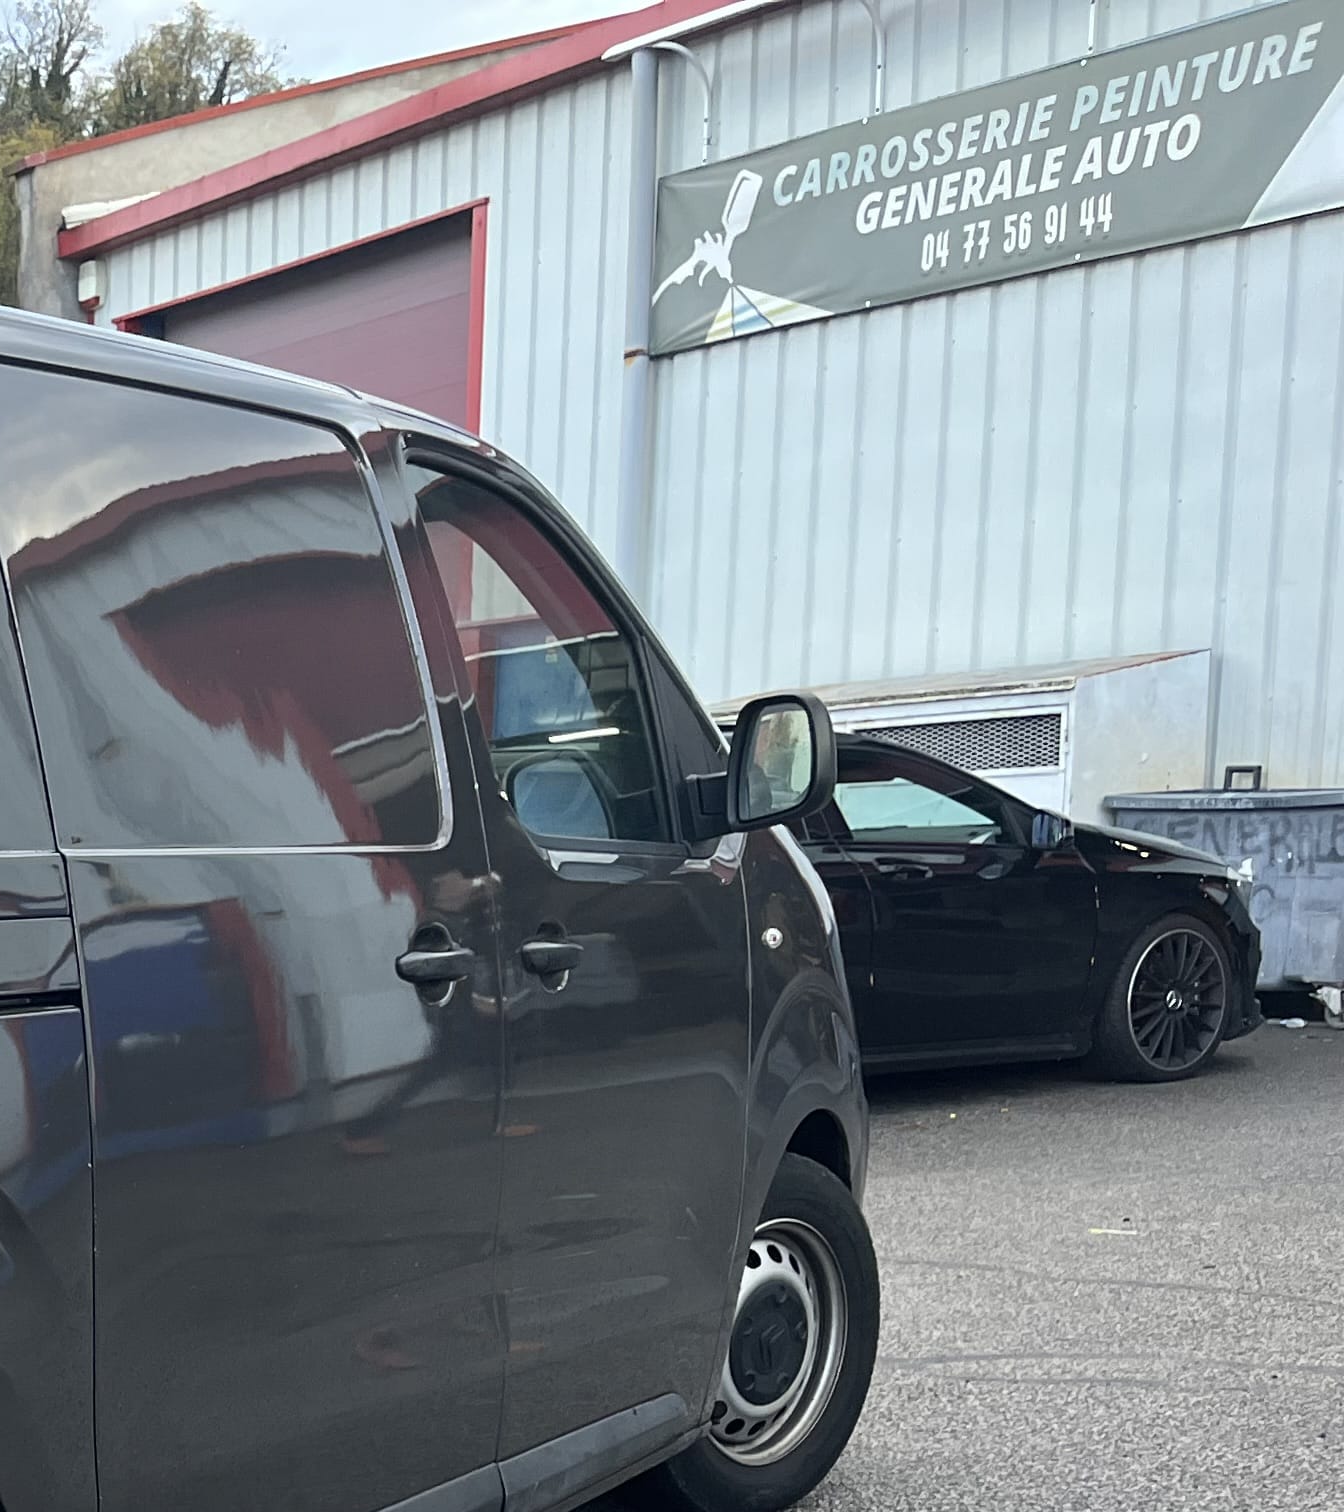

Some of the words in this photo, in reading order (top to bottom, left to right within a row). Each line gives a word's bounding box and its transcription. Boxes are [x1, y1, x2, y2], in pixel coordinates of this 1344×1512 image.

[773, 94, 1058, 206] CARROSSERIE
[1070, 22, 1324, 131] PEINTURE
[855, 145, 1067, 235] GENERALE
[1073, 113, 1201, 186] AUTO
[920, 229, 950, 272] 04
[963, 219, 991, 263] 77
[1003, 211, 1033, 254] 56
[1044, 202, 1068, 245] 91
[1079, 192, 1112, 237] 44
